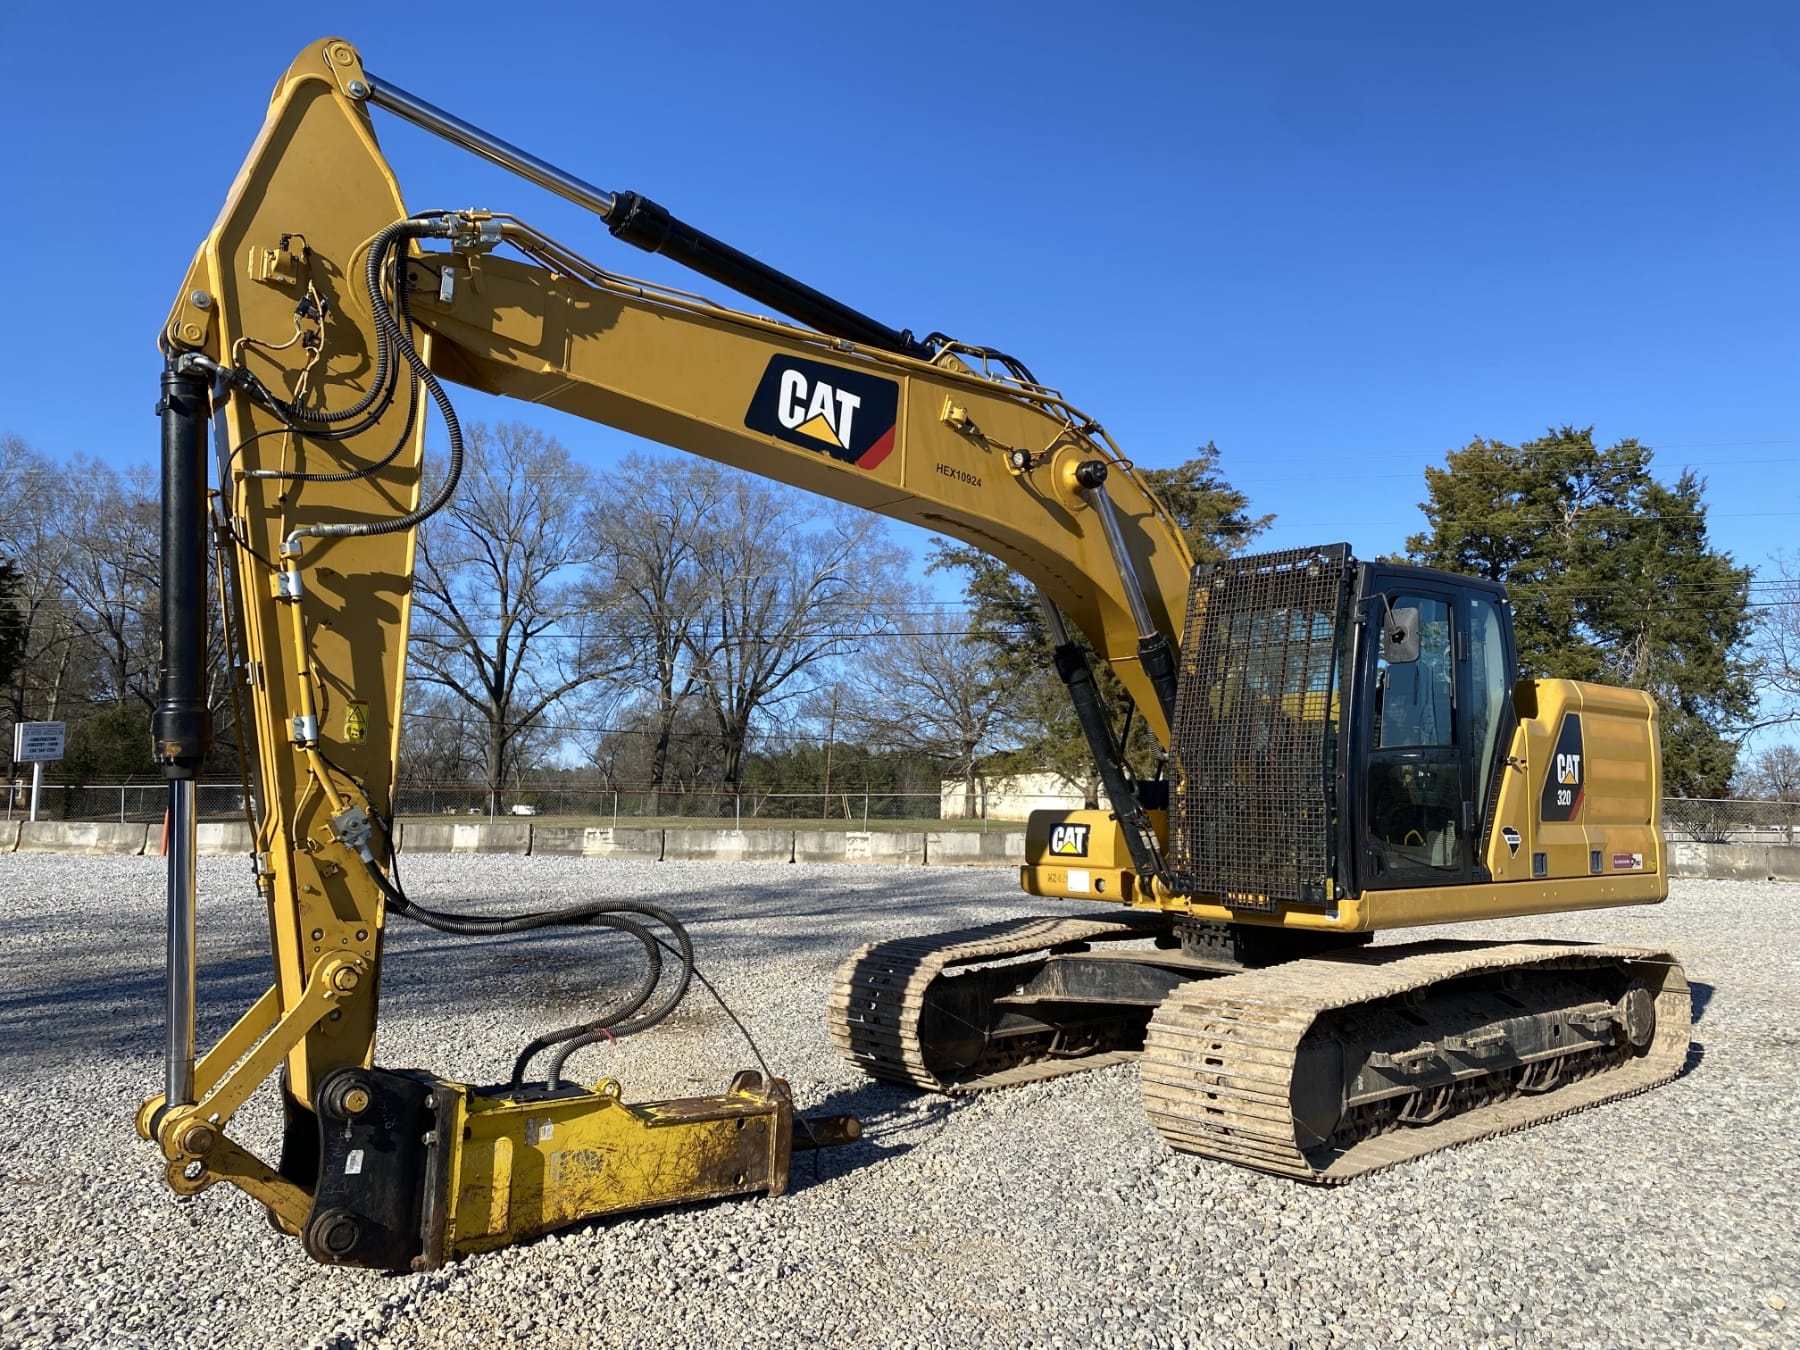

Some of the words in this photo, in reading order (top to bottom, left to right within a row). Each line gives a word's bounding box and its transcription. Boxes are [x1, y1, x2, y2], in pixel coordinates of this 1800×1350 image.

[777, 368, 861, 450] CAT
[936, 463, 982, 488] HEX10924
[1557, 752, 1580, 784] CAT
[1557, 789, 1571, 806] 320
[1052, 826, 1086, 854] CAT
